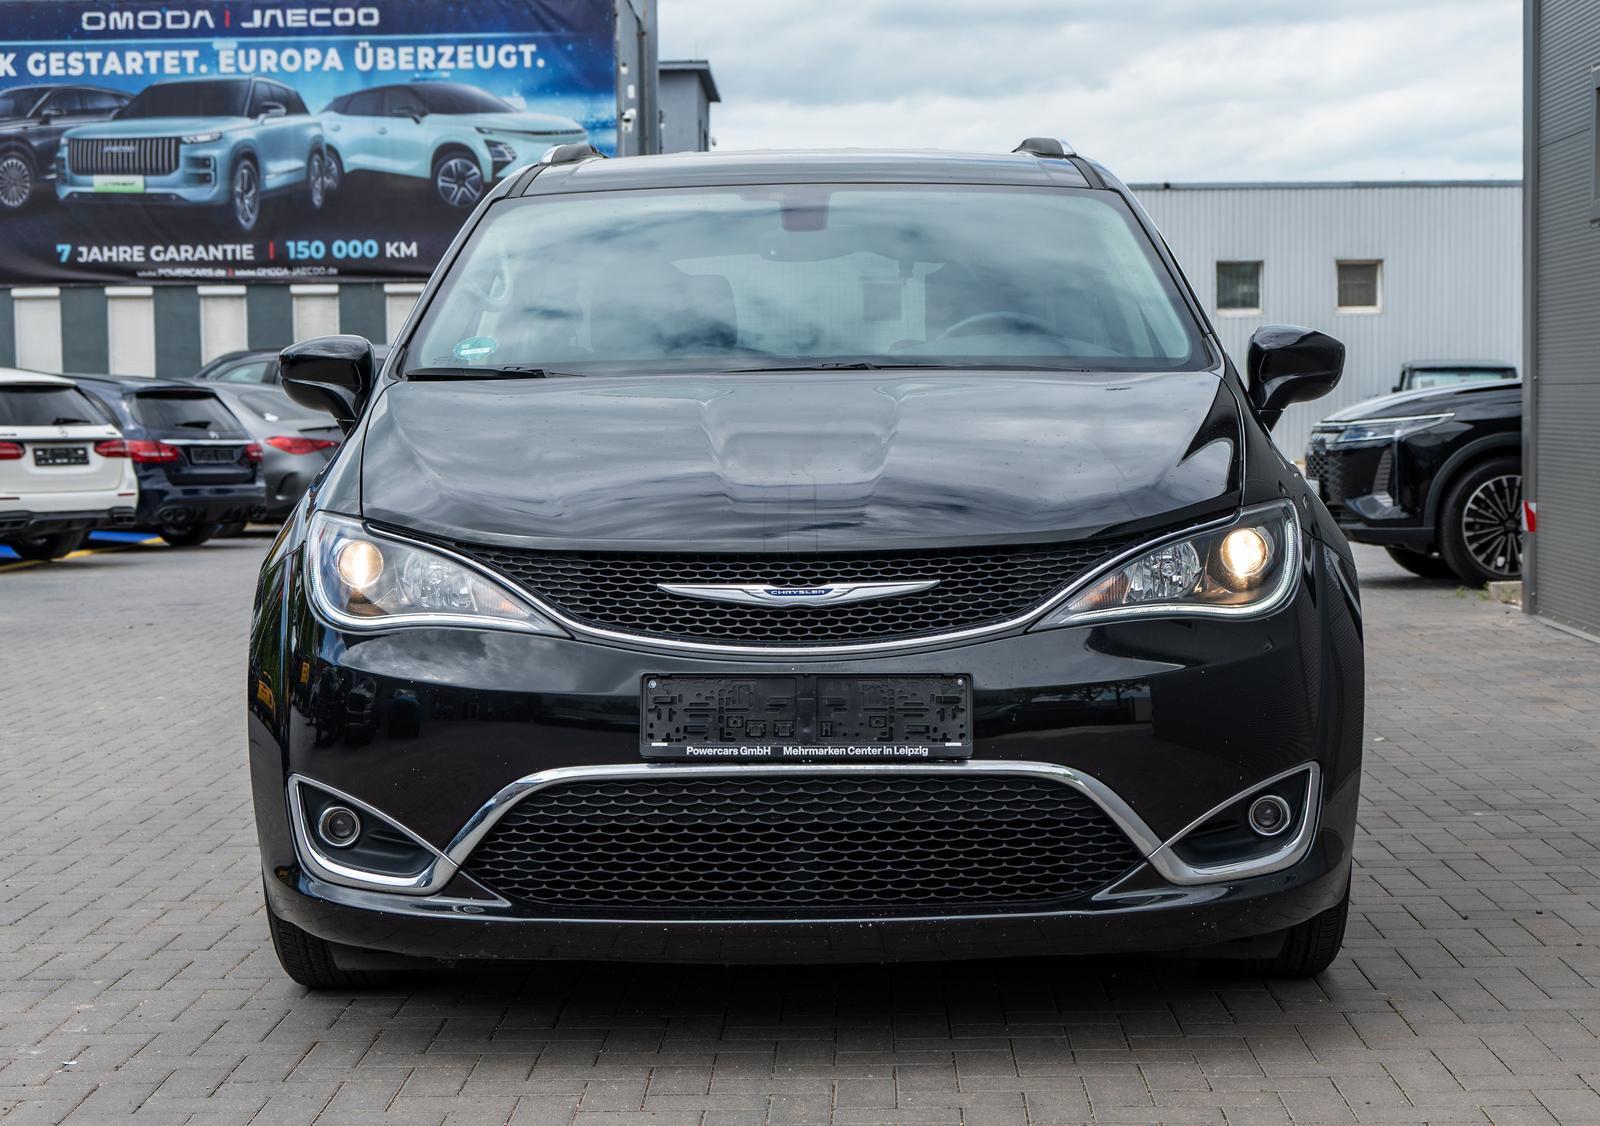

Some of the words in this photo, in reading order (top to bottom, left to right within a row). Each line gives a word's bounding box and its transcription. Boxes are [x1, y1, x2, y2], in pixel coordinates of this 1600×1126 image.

[81, 11, 215, 31] OMODA
[240, 7, 380, 29] JAECOO
[26, 49, 208, 77] GESTARTET.
[218, 47, 344, 74] EUROPA
[354, 41, 546, 71] ÜBERZEUGT.
[56, 244, 72, 263] 7
[77, 246, 146, 263] JAHRE
[150, 244, 256, 262] GARANTIE
[286, 240, 326, 260] 150
[331, 239, 379, 259] 000
[385, 241, 418, 258] KM
[686, 746, 739, 756] Powercars
[739, 746, 771, 756] GmbH
[783, 746, 846, 756] Mehrmarken
[847, 746, 882, 756] Center
[883, 745, 893, 756] in
[894, 745, 929, 757] Leipzig
